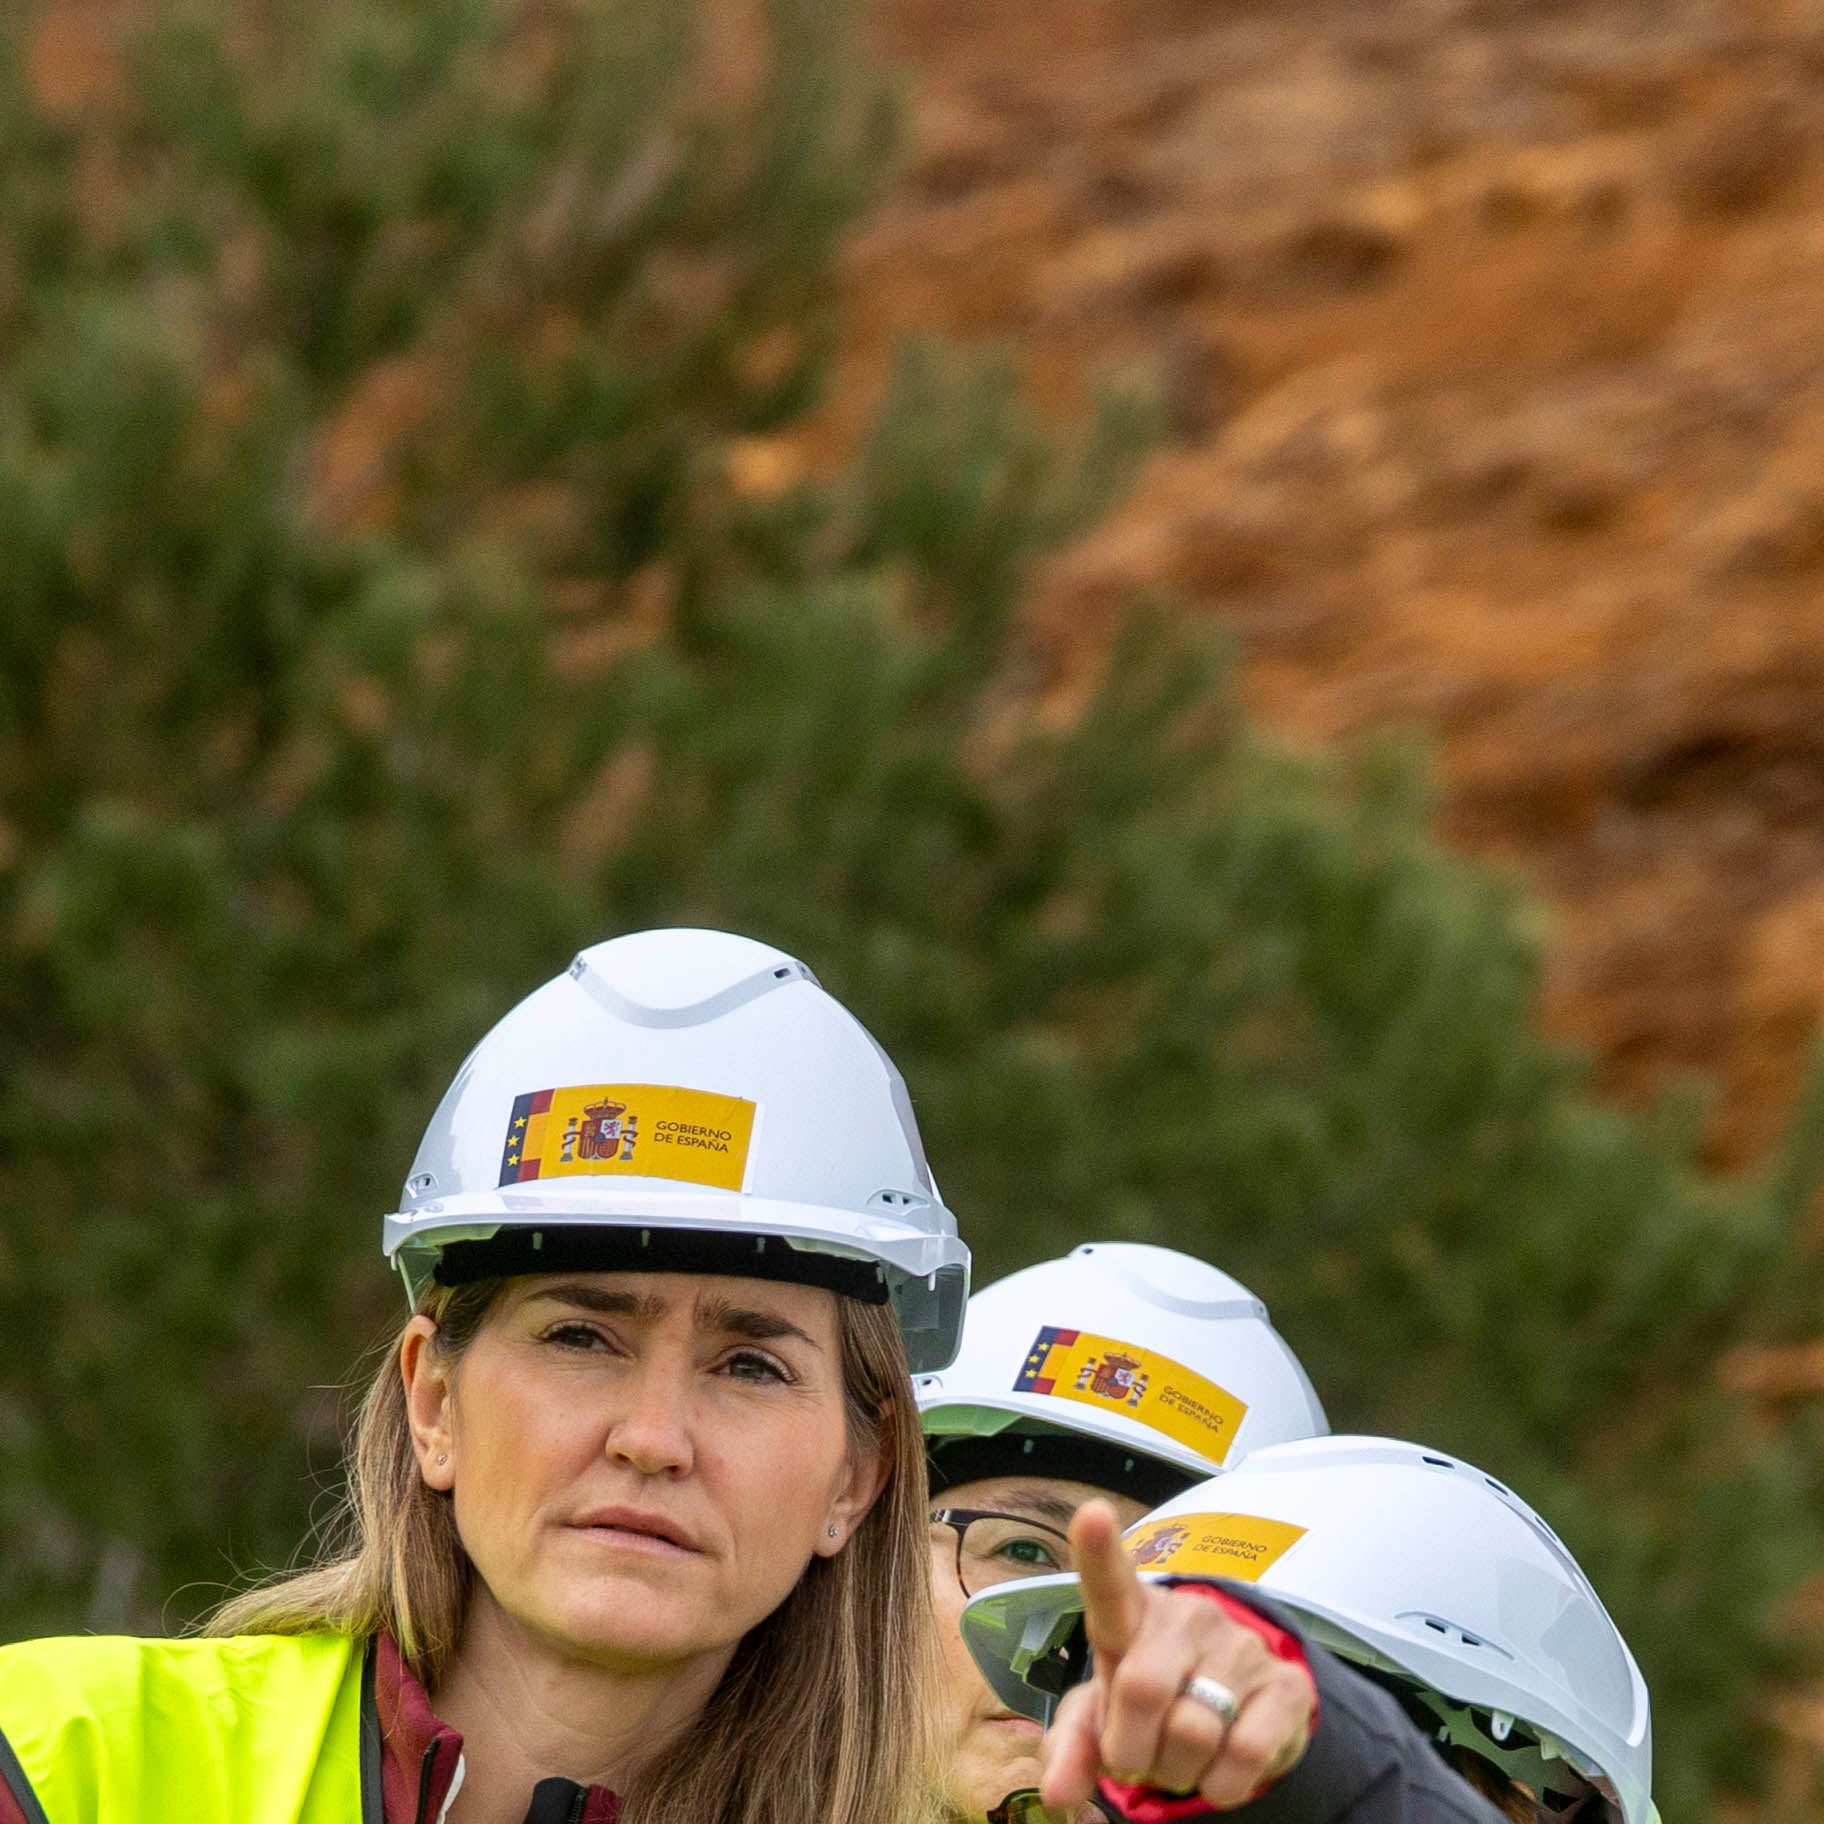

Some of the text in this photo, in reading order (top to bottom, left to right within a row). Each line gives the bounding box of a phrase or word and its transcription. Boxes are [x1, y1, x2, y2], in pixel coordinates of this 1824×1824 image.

[656, 1120, 732, 1142] GOBIERNO
[654, 1132, 729, 1154] DE ESPAÑA
[1159, 1394, 1220, 1434] DE ESPAÑA
[1163, 1386, 1224, 1425] GOBIERNO
[1192, 1544, 1258, 1562] DE ESPAÑA
[1202, 1535, 1268, 1553] GOBIERNO
